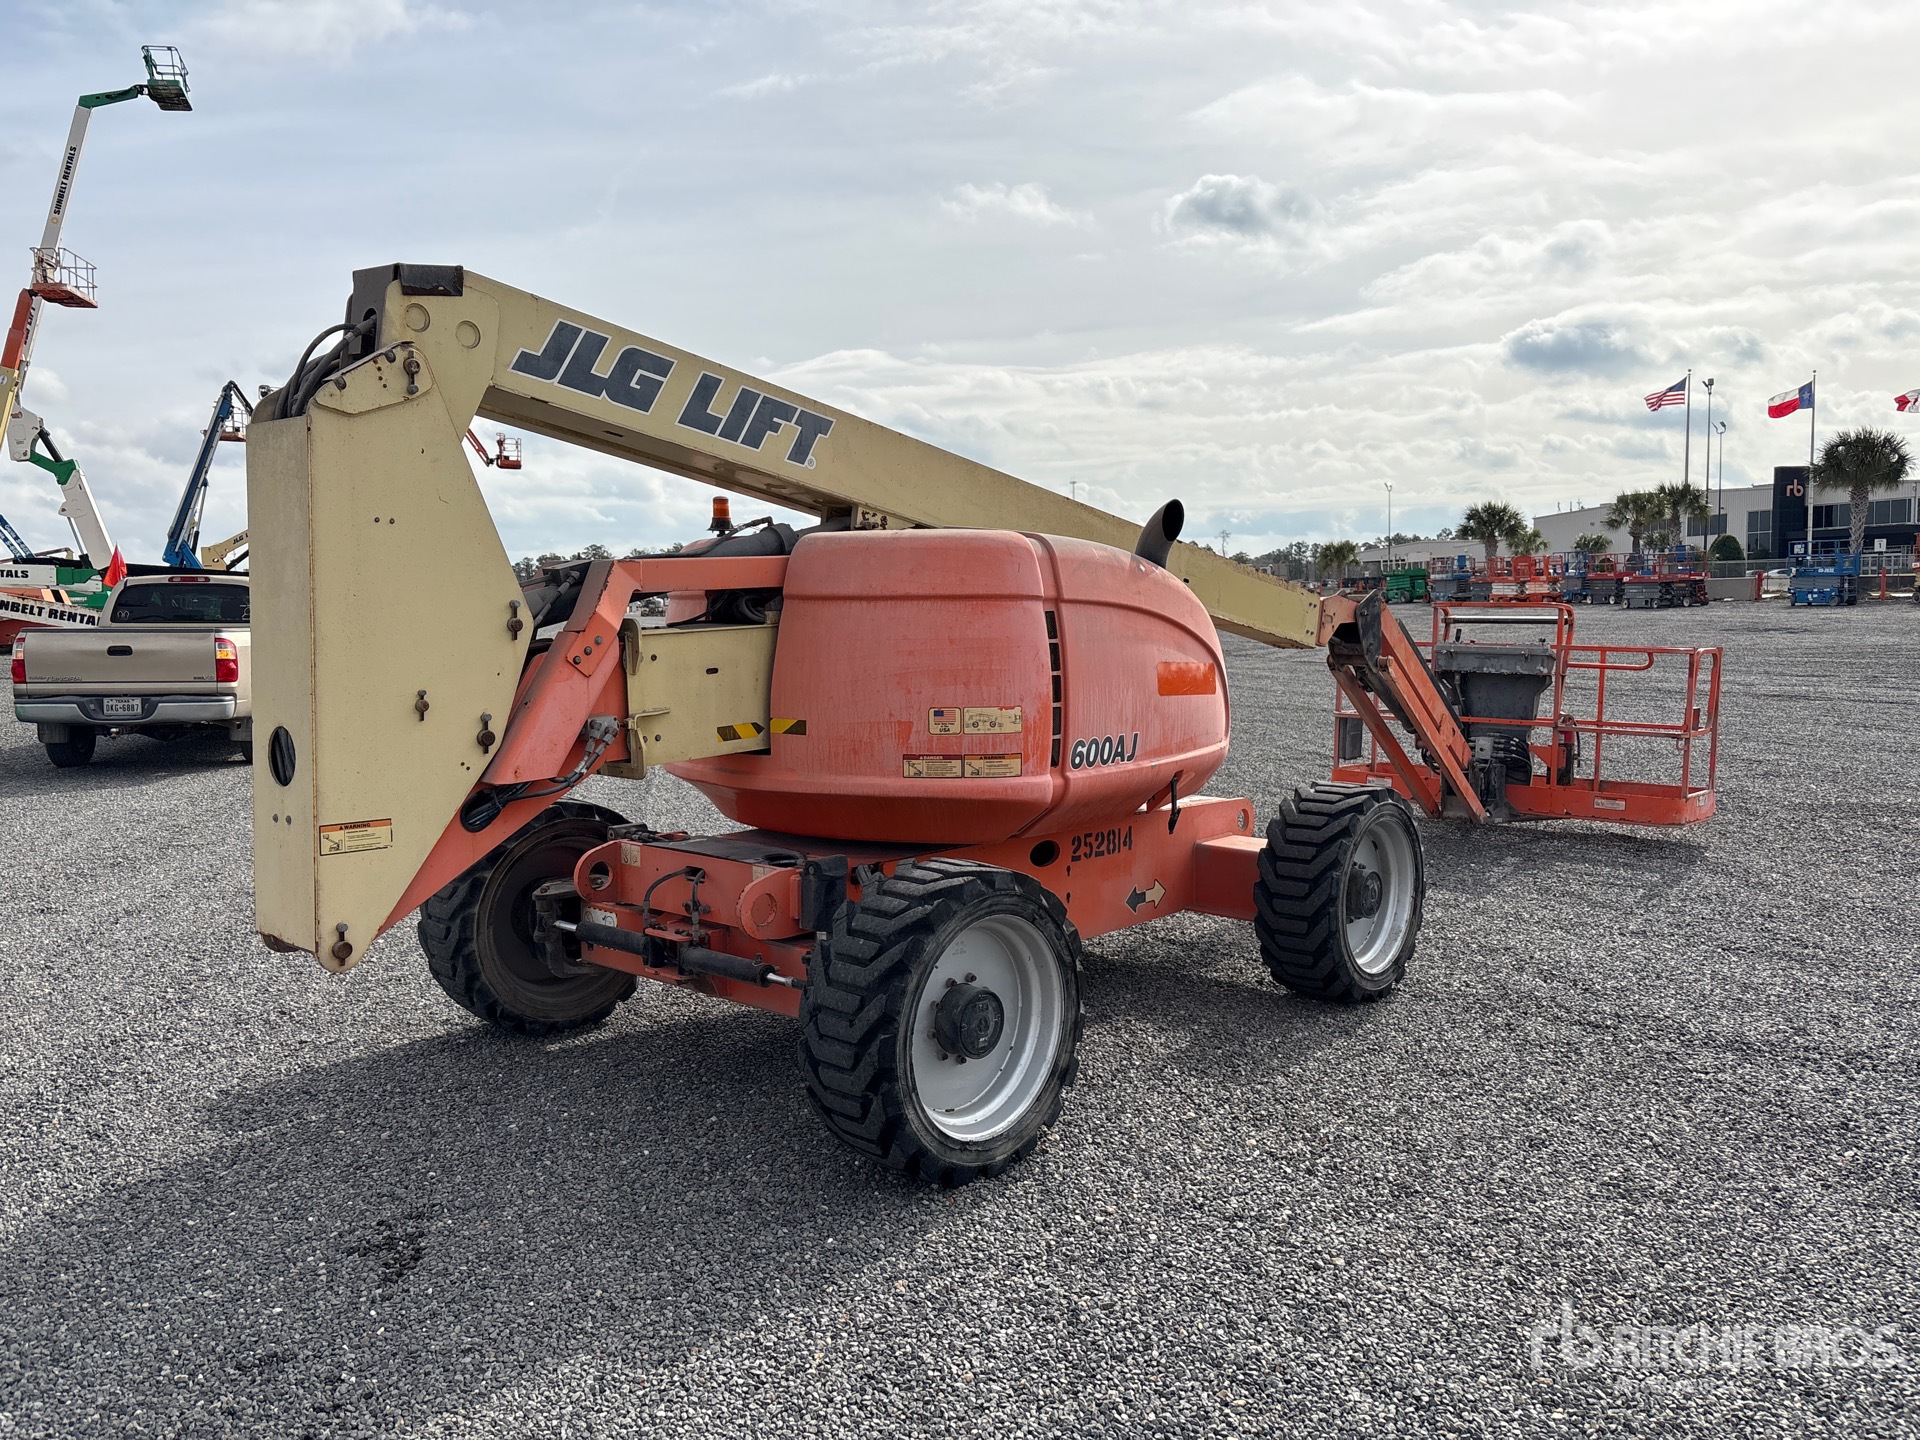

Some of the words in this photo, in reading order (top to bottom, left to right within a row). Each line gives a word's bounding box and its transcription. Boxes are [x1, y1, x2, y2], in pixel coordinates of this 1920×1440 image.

[53, 181, 68, 215] SUNBELT
[62, 145, 77, 180] RENTALS
[507, 318, 678, 415] JLG
[674, 370, 836, 470] LIFT
[1786, 479, 1804, 497] rb
[1070, 732, 1139, 770] 600AJ
[344, 822, 371, 830] WARNING
[1071, 825, 1133, 862] 252814
